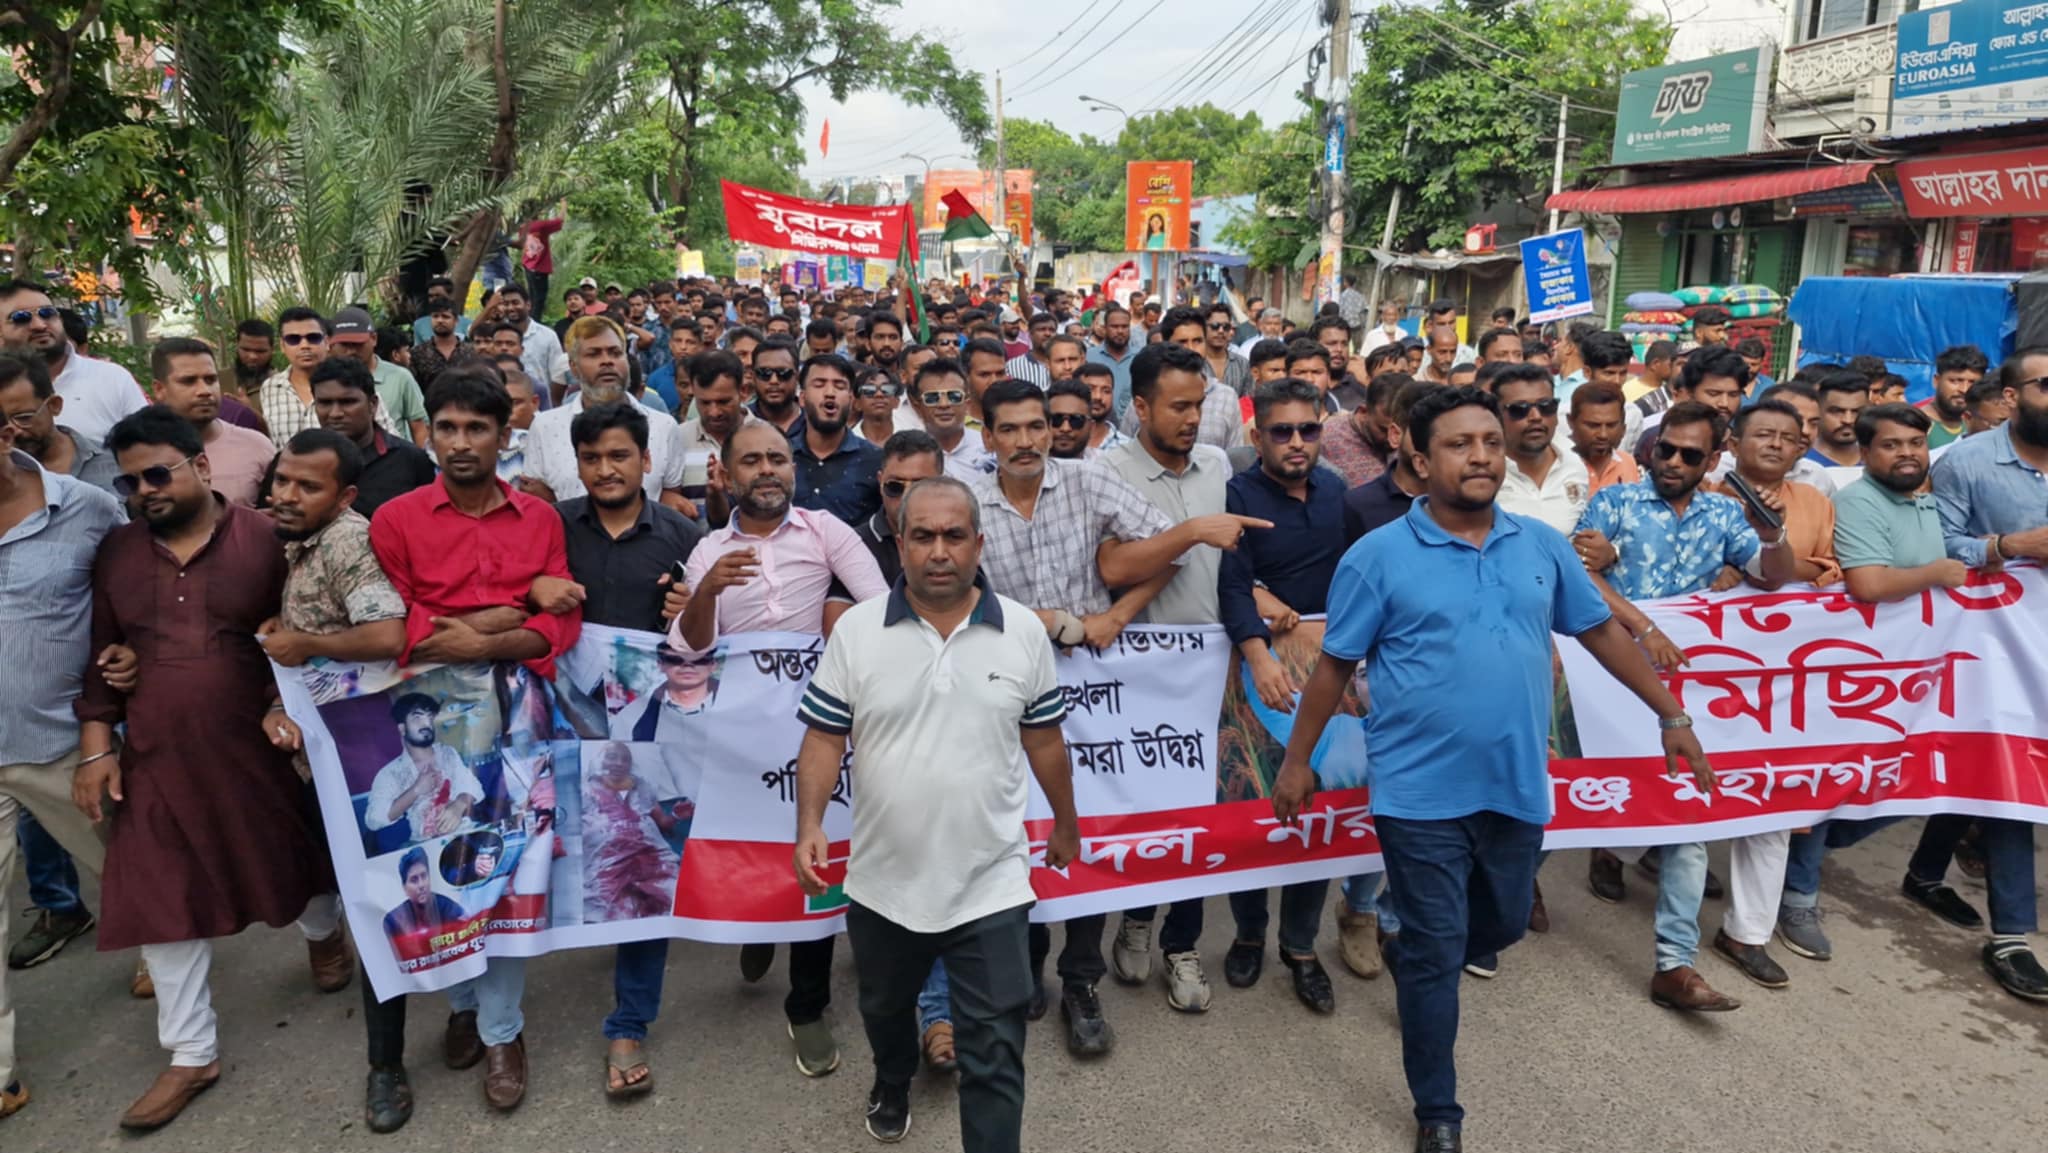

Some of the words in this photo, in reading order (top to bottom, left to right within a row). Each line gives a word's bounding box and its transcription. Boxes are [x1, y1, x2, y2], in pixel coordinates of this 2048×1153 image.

[1653, 72, 1712, 115] BRB
[1898, 61, 1976, 85] EUROASIA
[1910, 168, 2004, 207] আল্লাহর
[755, 202, 883, 240] যুবদল
[1131, 723, 1206, 771] উদ্বিগ্ন
[1660, 751, 1915, 809] মহানগর
